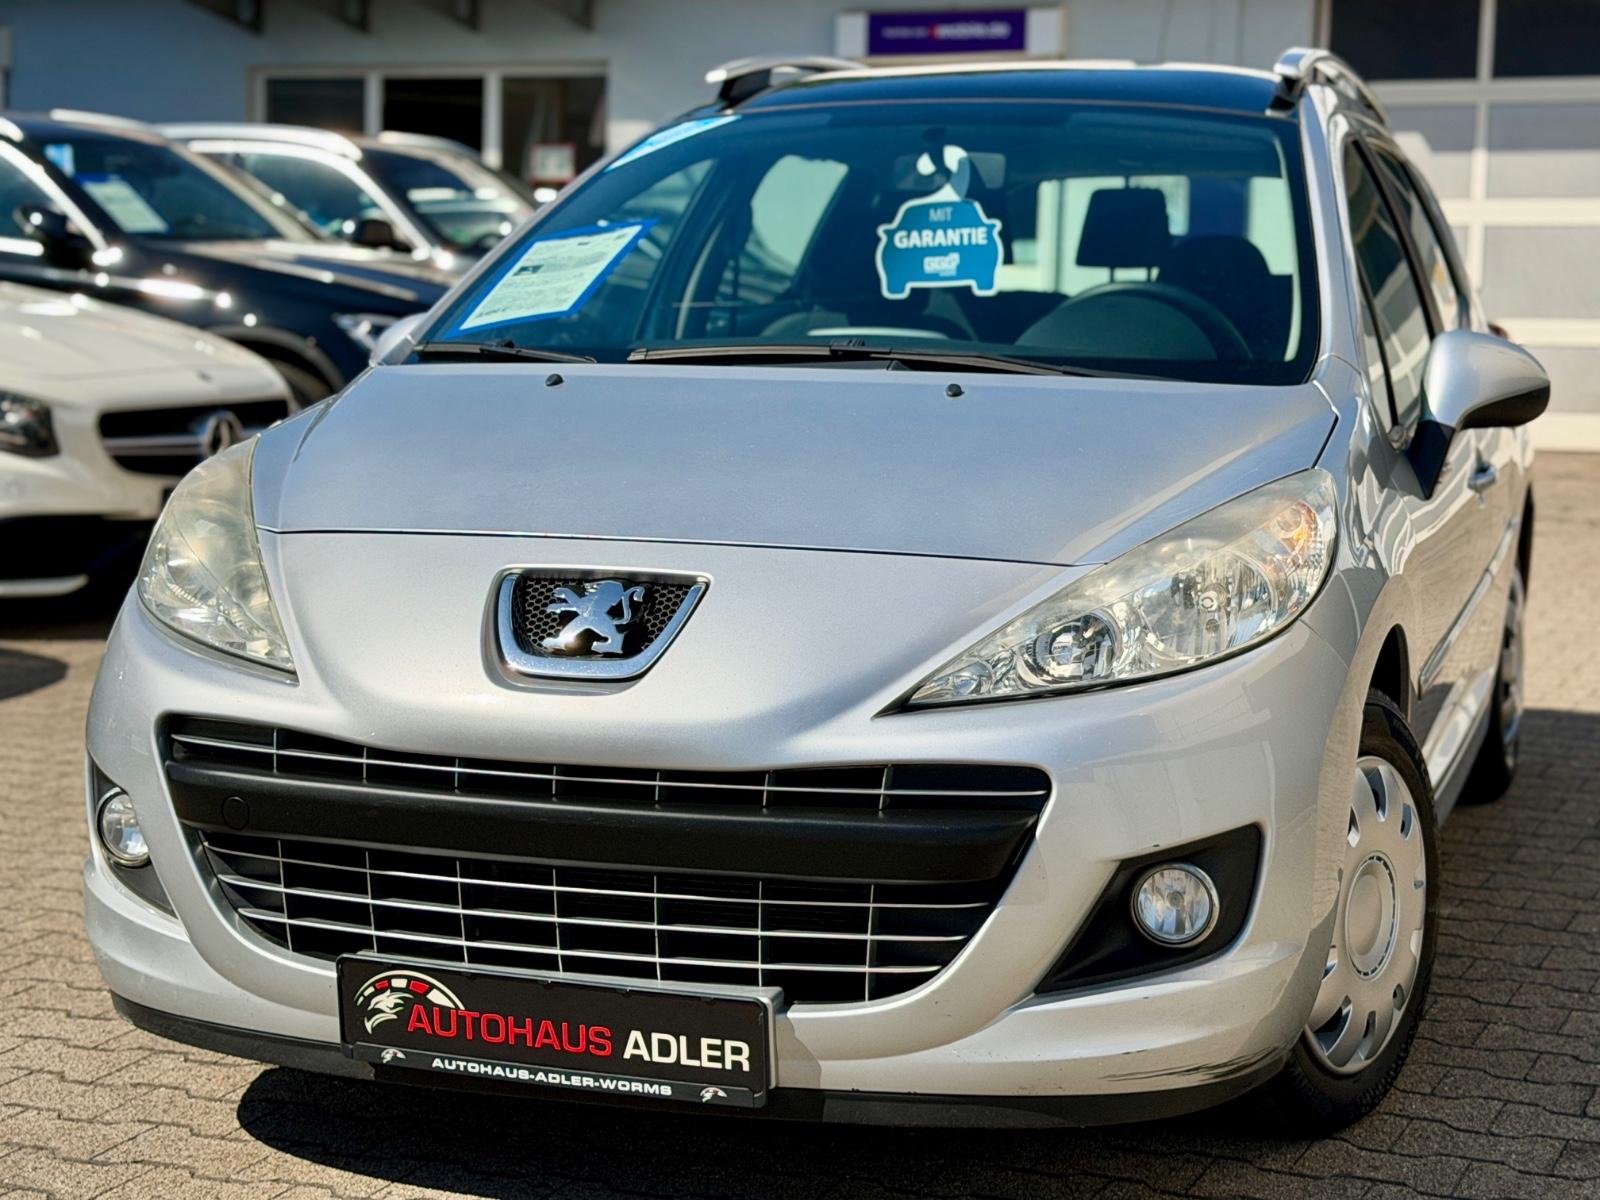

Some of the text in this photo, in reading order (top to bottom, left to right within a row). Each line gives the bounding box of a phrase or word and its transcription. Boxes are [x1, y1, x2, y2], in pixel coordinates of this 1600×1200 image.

[928, 207, 953, 222] MIT
[893, 227, 988, 249] GARANTIE
[407, 1003, 750, 1072] AUTOHAUS ADLER
[431, 1058, 673, 1096] AUTOHAUS-ADLER-WORMS
